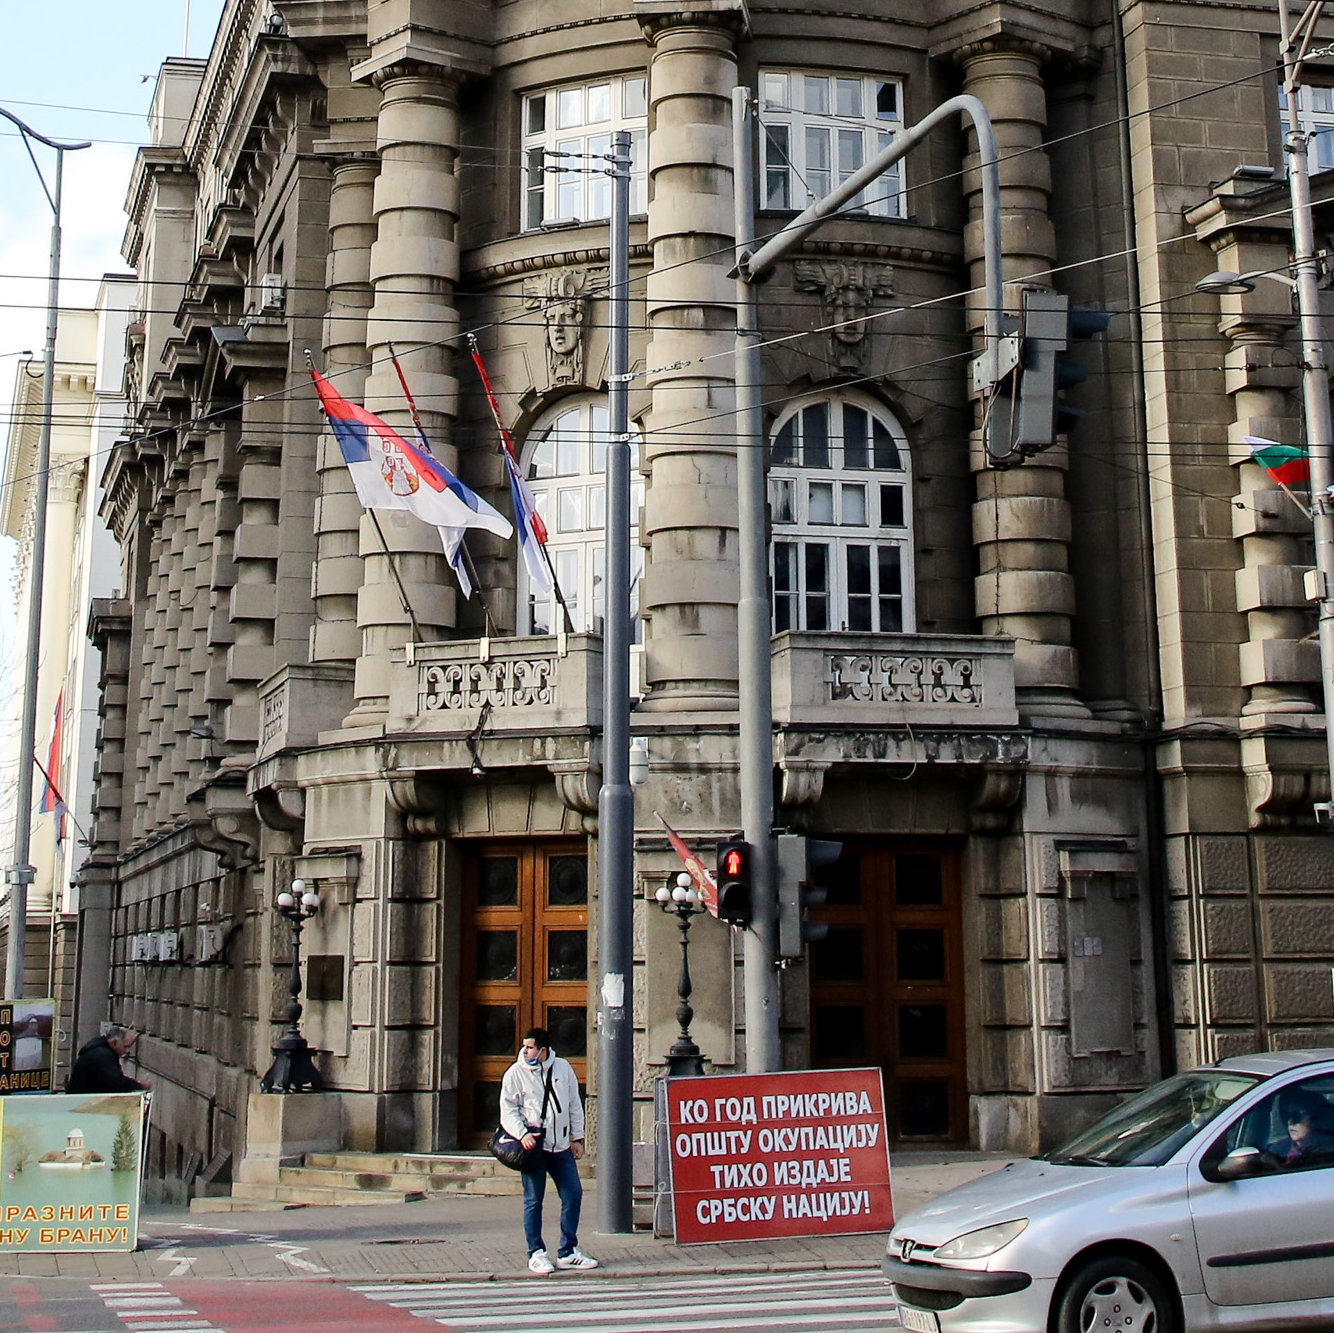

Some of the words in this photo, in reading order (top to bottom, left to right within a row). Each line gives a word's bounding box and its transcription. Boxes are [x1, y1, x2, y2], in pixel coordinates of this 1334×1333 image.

[680, 1099, 709, 1124] КО
[714, 1097, 758, 1125] ГОД
[762, 1091, 873, 1119] ПРИКРИВА
[675, 1130, 753, 1157] ОПШТУ
[758, 1123, 880, 1153] ОКУПАЦИЈУ
[710, 1163, 768, 1188] ТИХО
[773, 1158, 852, 1188] ИЗДАЈЕ
[696, 1196, 777, 1224] СРБСКУ
[782, 1190, 871, 1222] НАЦИЈУ!
[40, 1227, 129, 1246] БРАНУ!
